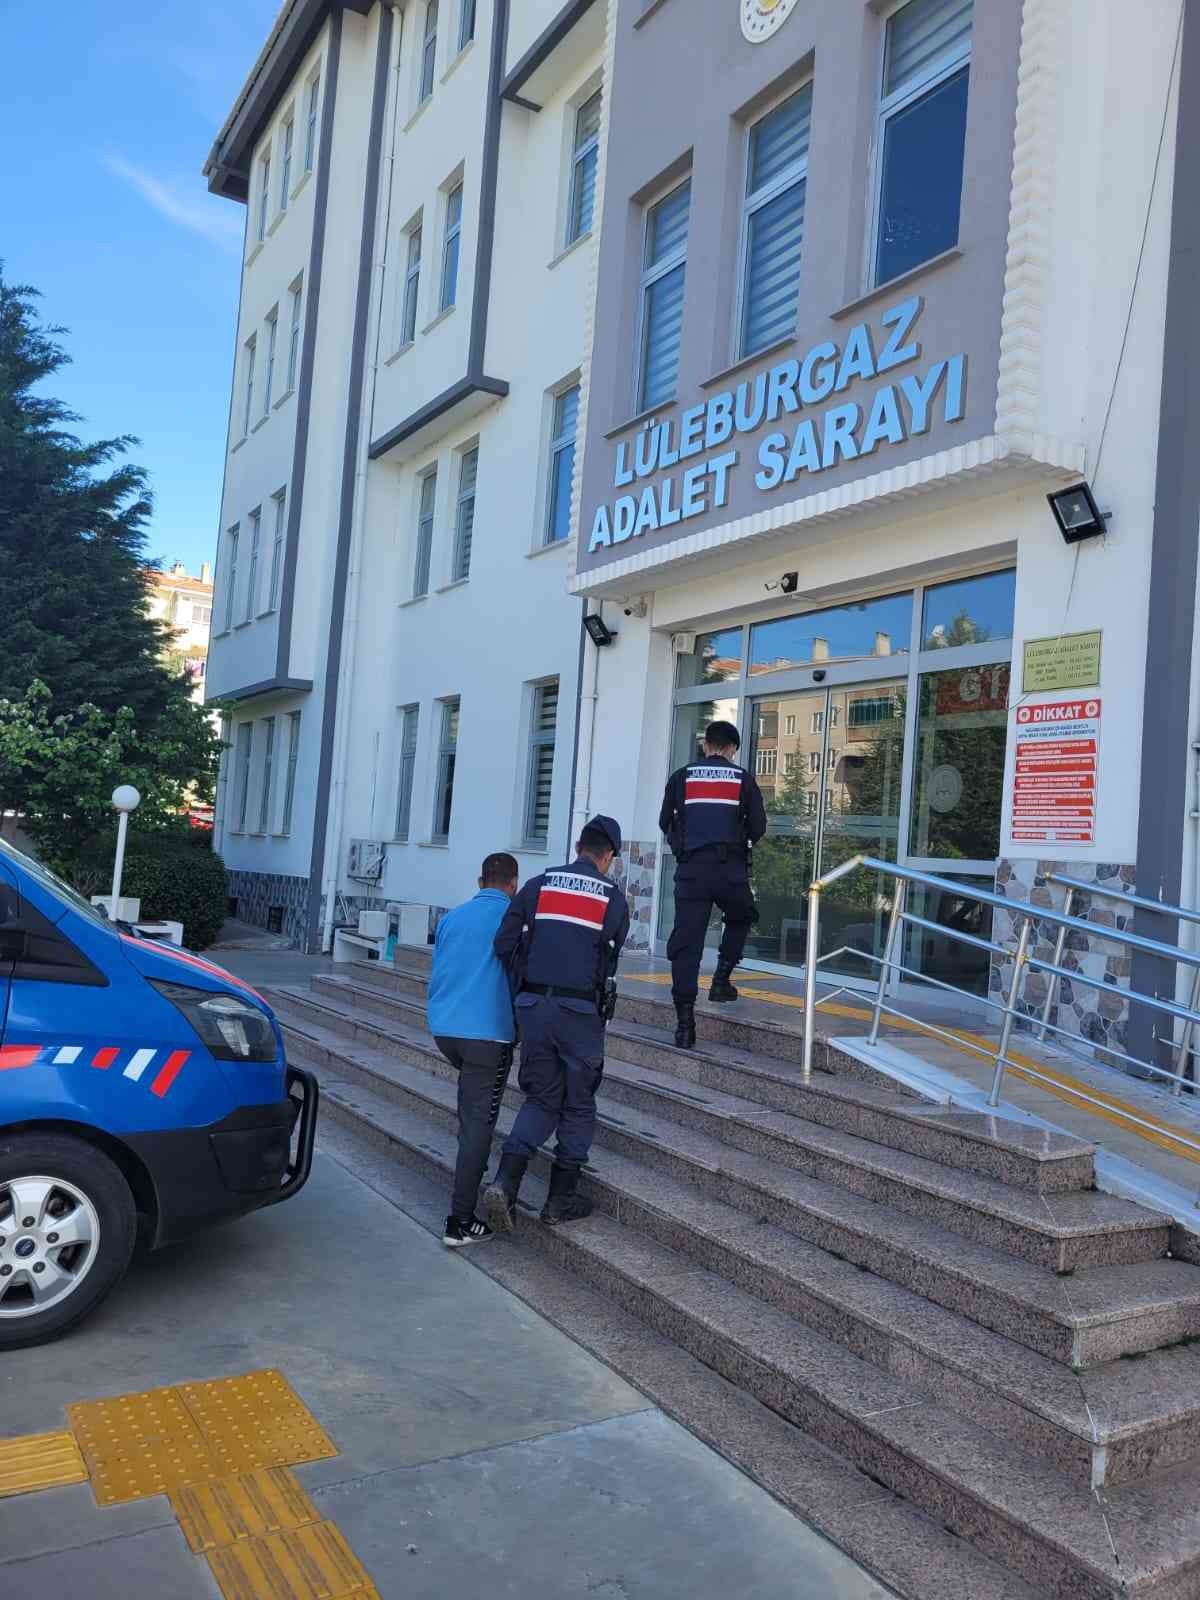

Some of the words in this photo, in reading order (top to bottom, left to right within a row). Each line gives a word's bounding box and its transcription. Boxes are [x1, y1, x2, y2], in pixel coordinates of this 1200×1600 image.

[613, 295, 924, 488] LÜLEBURGAZ
[588, 448, 738, 553] ADALET
[755, 353, 967, 490] SARAYI
[1033, 704, 1082, 721] DİKKAT
[690, 769, 736, 779] JANDARMA
[549, 874, 604, 896] JANDARMA
